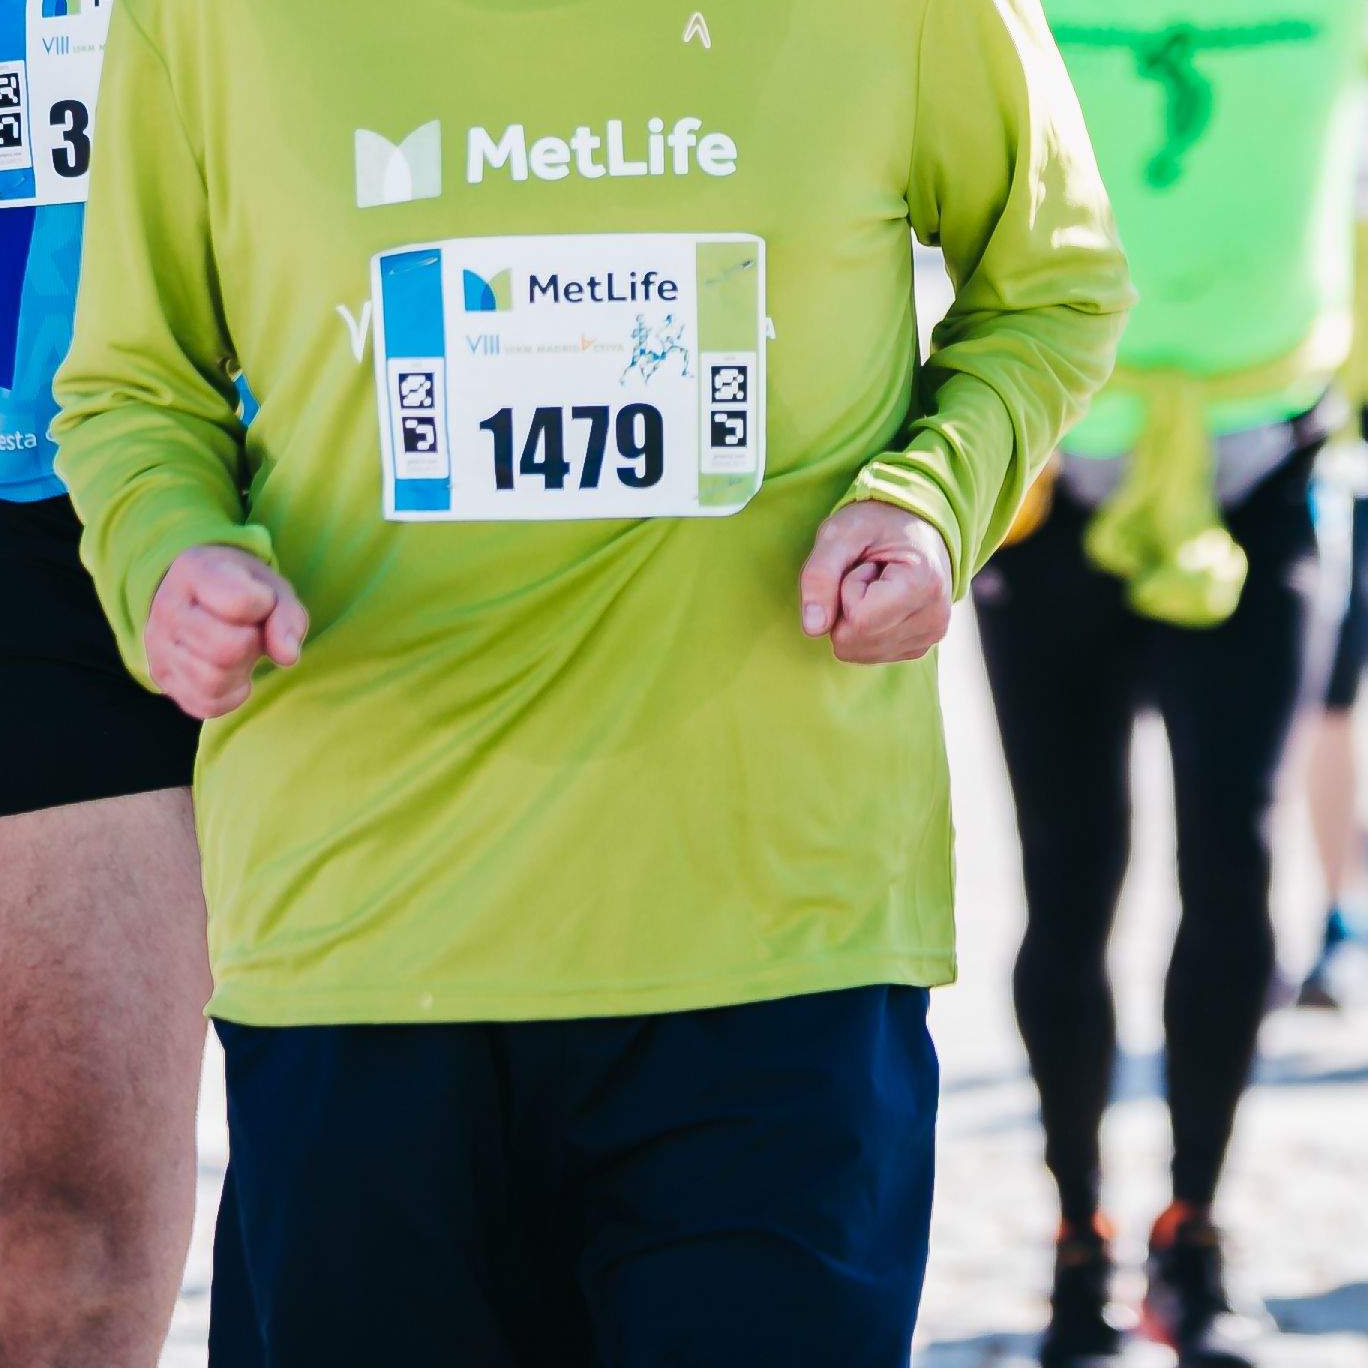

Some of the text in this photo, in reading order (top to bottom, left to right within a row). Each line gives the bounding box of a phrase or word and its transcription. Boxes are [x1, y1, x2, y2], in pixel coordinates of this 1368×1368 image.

[466, 116, 738, 184] MetLife
[528, 271, 679, 304] MetLife
[465, 333, 501, 356] VIII
[479, 402, 664, 491] 1479
